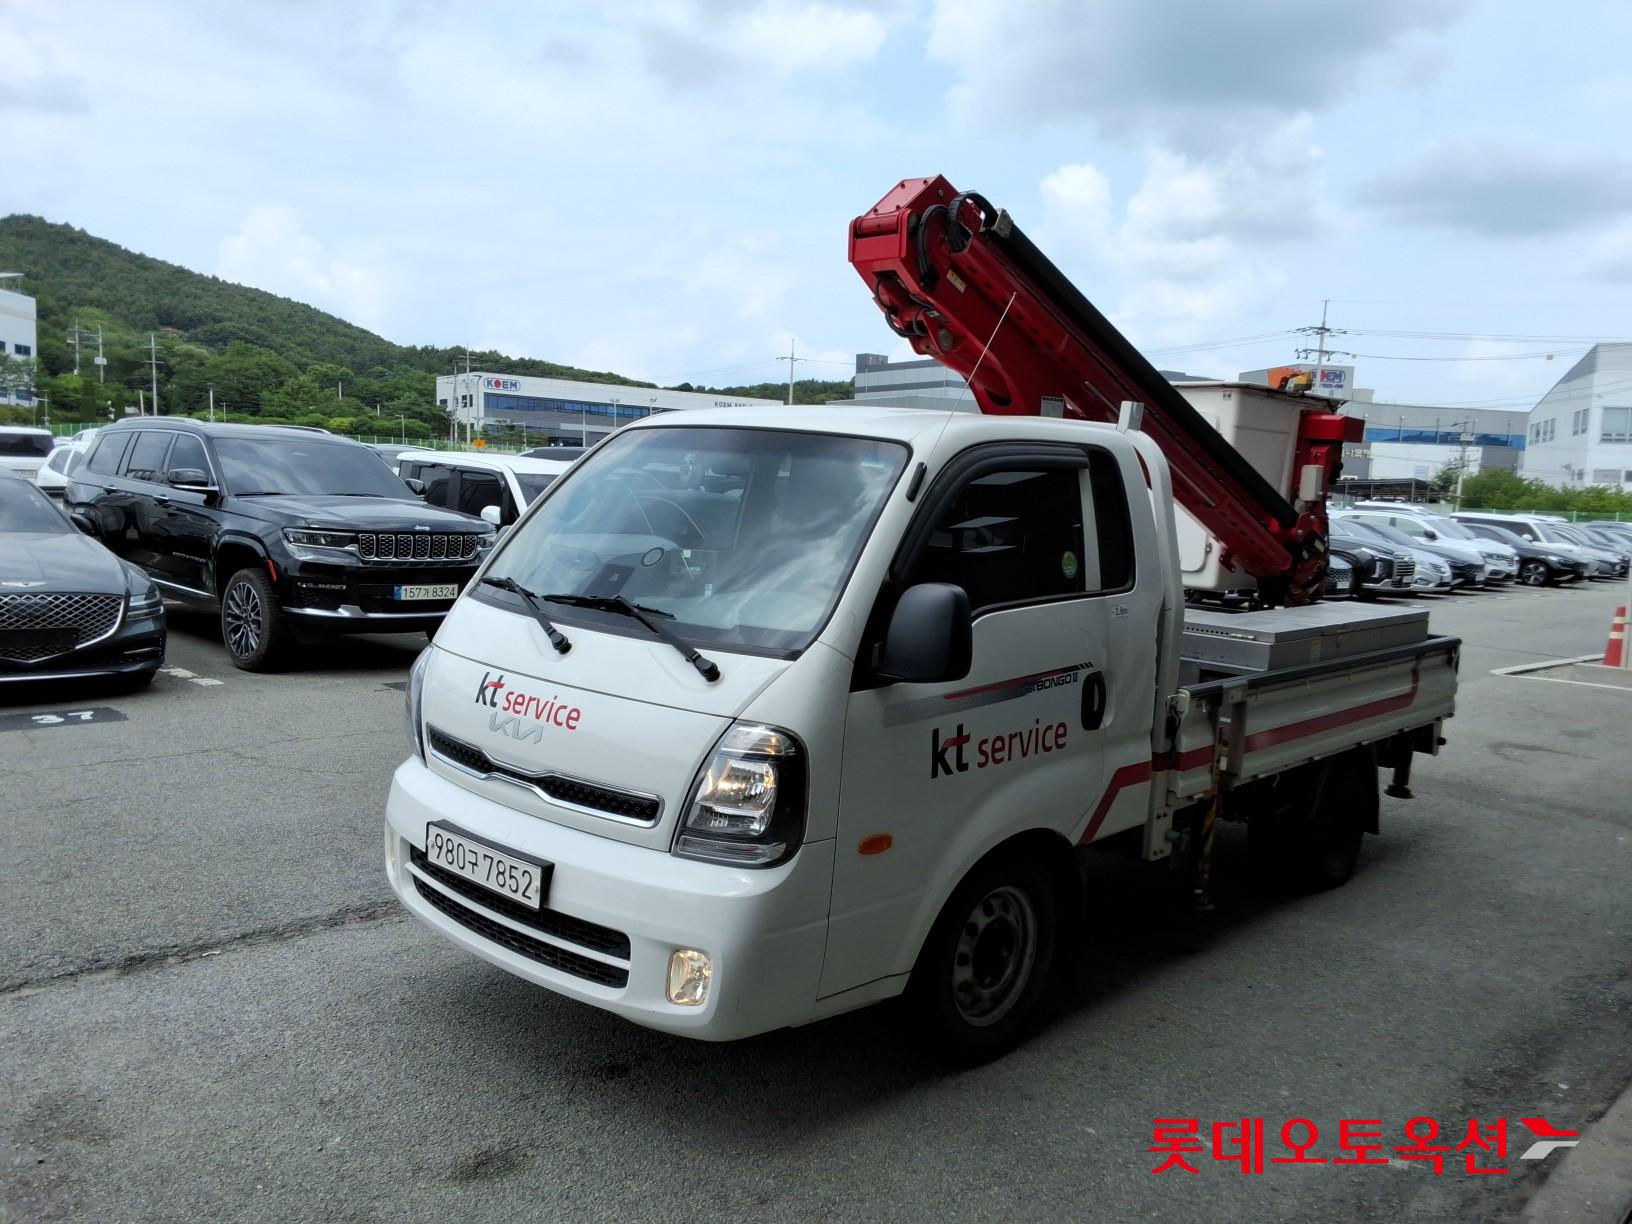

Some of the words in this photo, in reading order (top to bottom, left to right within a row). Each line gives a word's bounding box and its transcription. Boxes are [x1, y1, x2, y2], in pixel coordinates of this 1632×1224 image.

[485, 379, 519, 390] KOEM
[475, 671, 505, 708] kt
[502, 691, 581, 730] service
[931, 723, 971, 779] kt
[976, 718, 1067, 769] service
